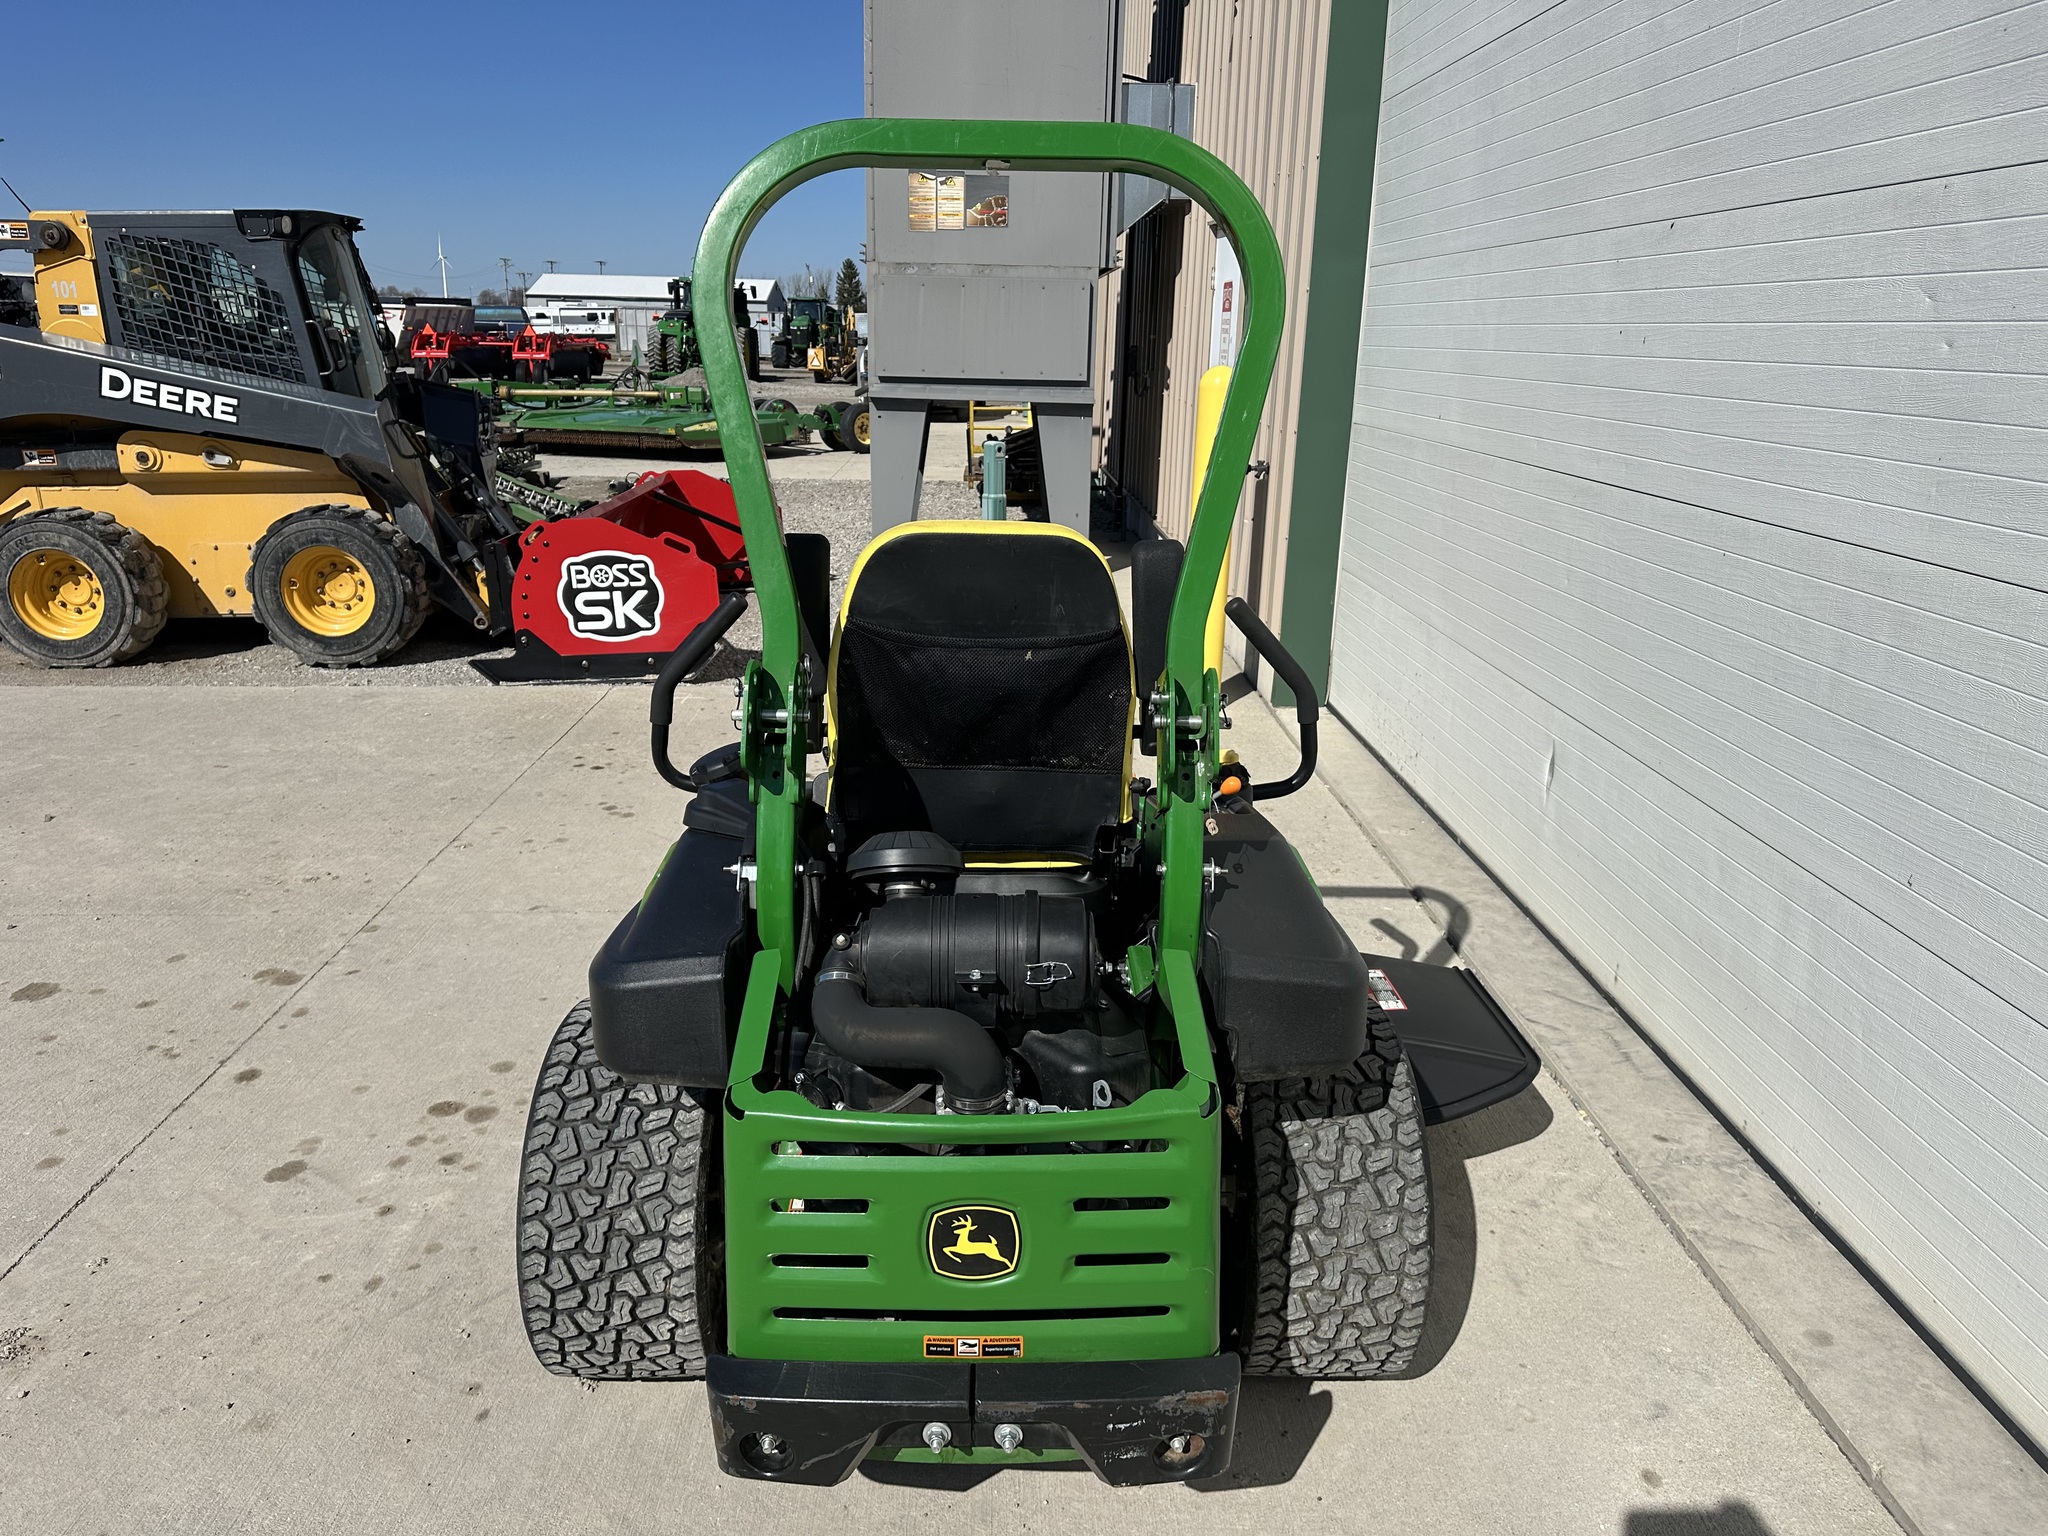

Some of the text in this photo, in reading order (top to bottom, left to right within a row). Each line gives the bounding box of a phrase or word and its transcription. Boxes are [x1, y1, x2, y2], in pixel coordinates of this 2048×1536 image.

[51, 280, 78, 299] 101
[101, 366, 238, 423] DEERE
[569, 563, 647, 589] BOSS
[574, 590, 652, 631] SK
